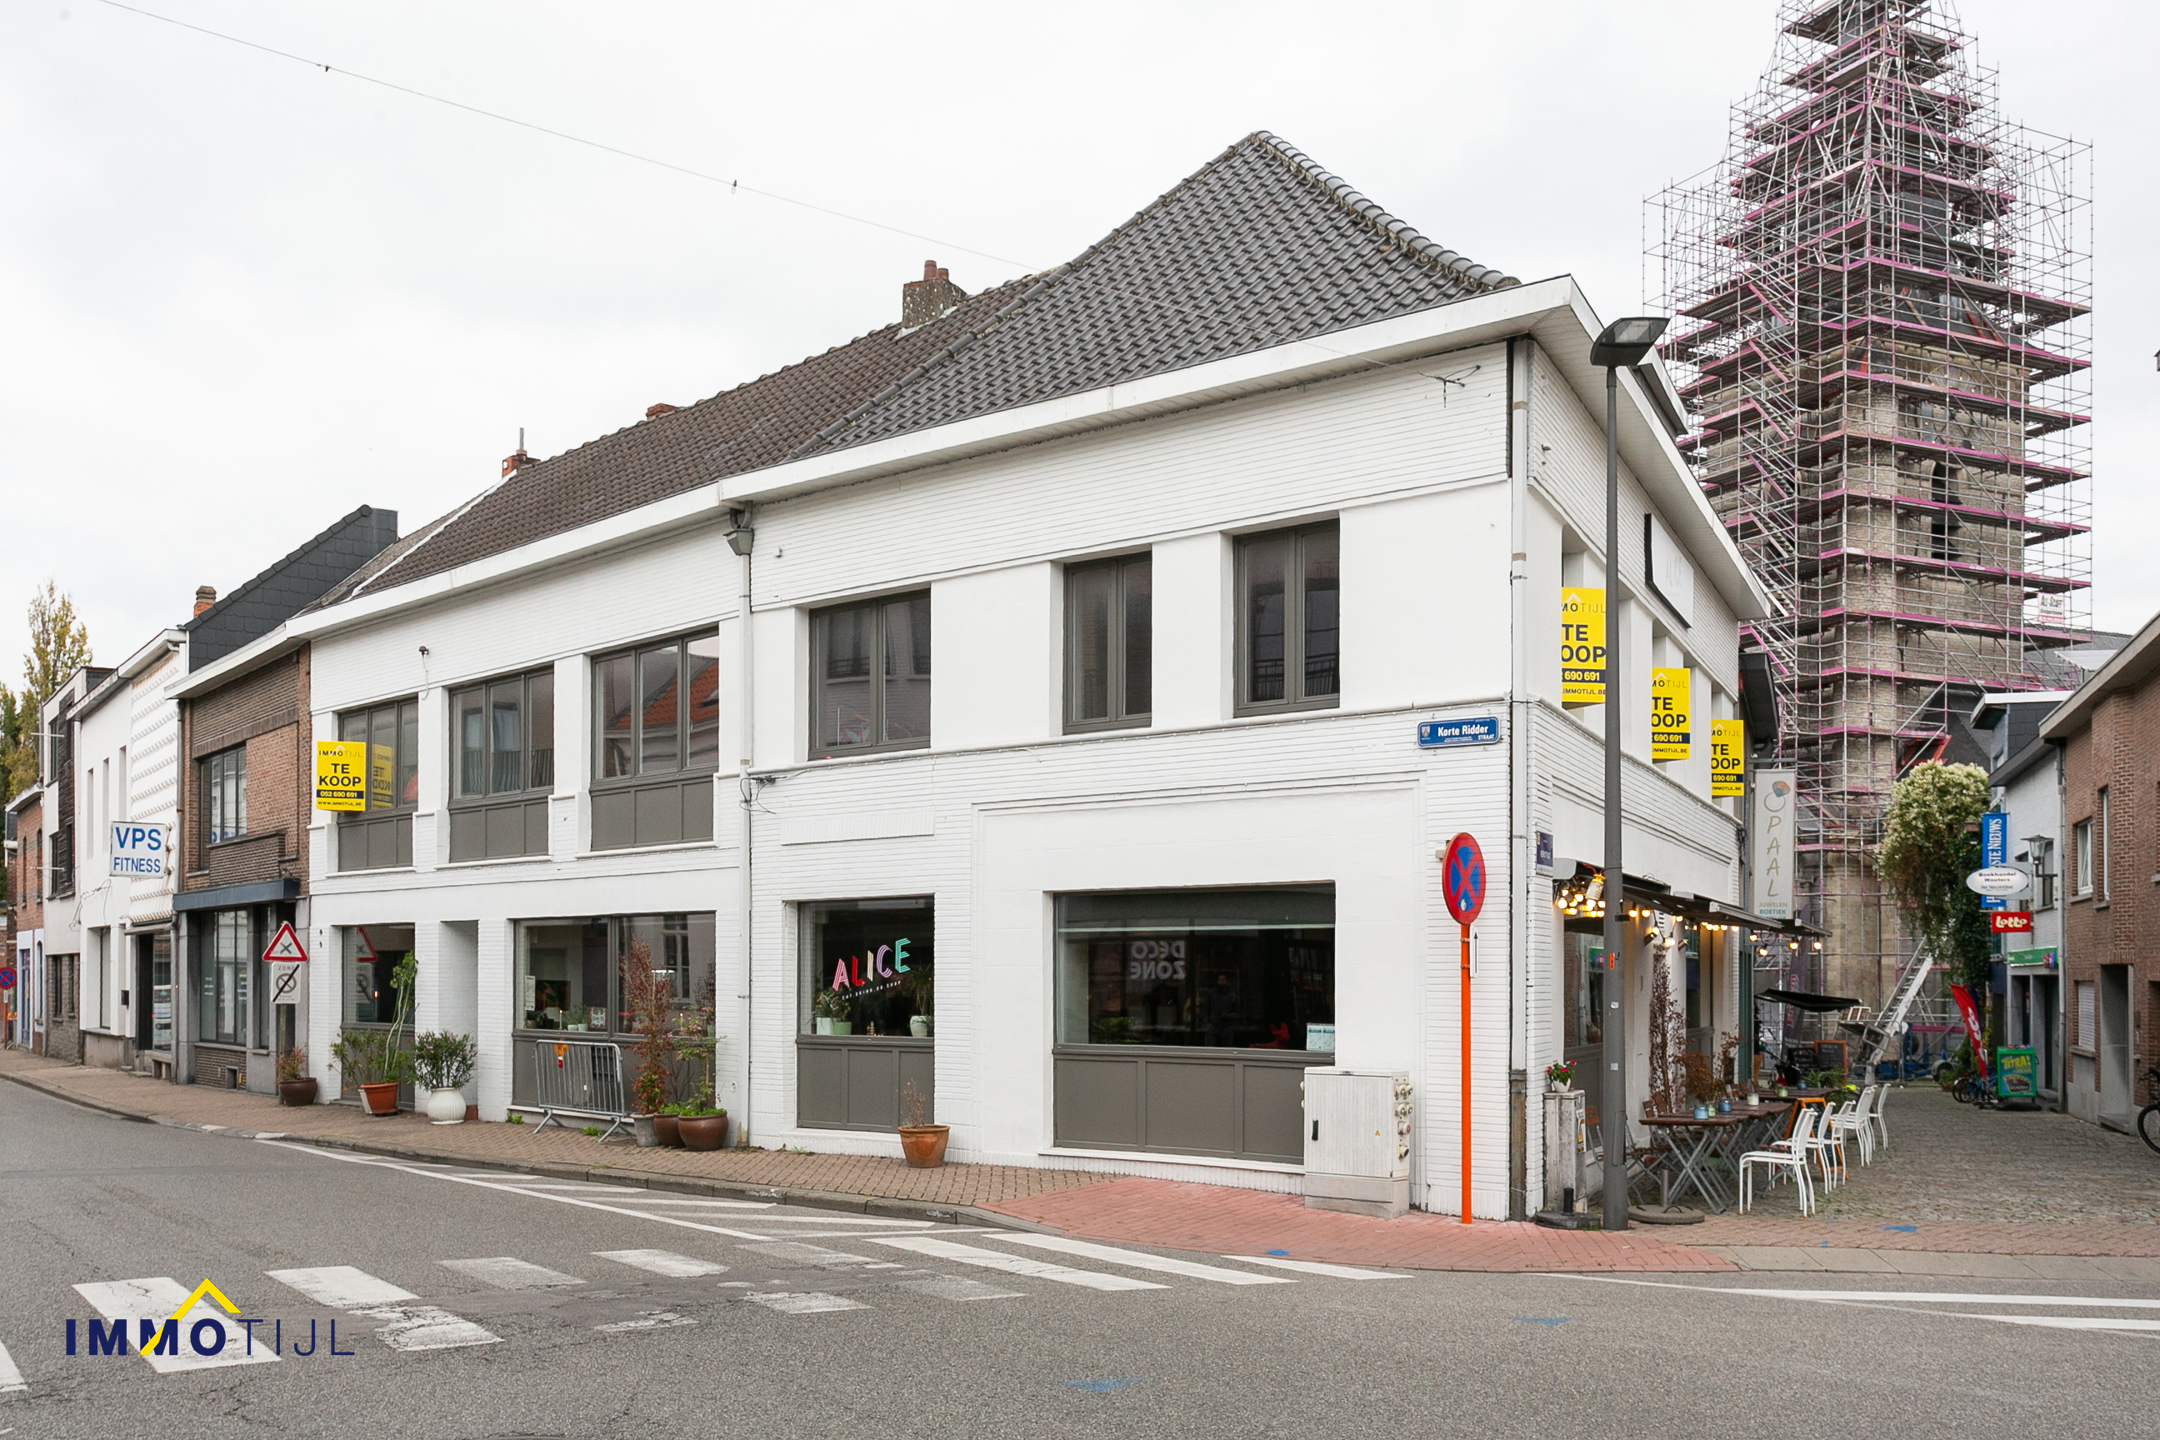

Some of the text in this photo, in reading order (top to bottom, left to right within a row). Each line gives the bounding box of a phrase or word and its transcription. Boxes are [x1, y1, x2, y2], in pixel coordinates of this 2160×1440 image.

[1561, 603, 1605, 613] MOTIJL
[1562, 624, 1588, 641] TE
[1561, 645, 1605, 662] OOP
[1564, 671, 1600, 681] 690 691
[1652, 680, 1687, 688] MOTIJL
[1652, 697, 1673, 711] TE
[1652, 714, 1687, 727] OOP
[1438, 724, 1489, 737] Korte Ridder
[1654, 734, 1682, 742] 690 691
[1711, 744, 1729, 755] TE
[331, 763, 350, 774] TE
[1711, 758, 1740, 769] OOP
[318, 776, 361, 787] KOOP
[115, 827, 161, 851] VPS
[1988, 818, 2002, 850] NIEUWS
[114, 857, 161, 872] FITNESS
[1995, 915, 2028, 928] Lotto
[832, 937, 911, 992] ALICE
